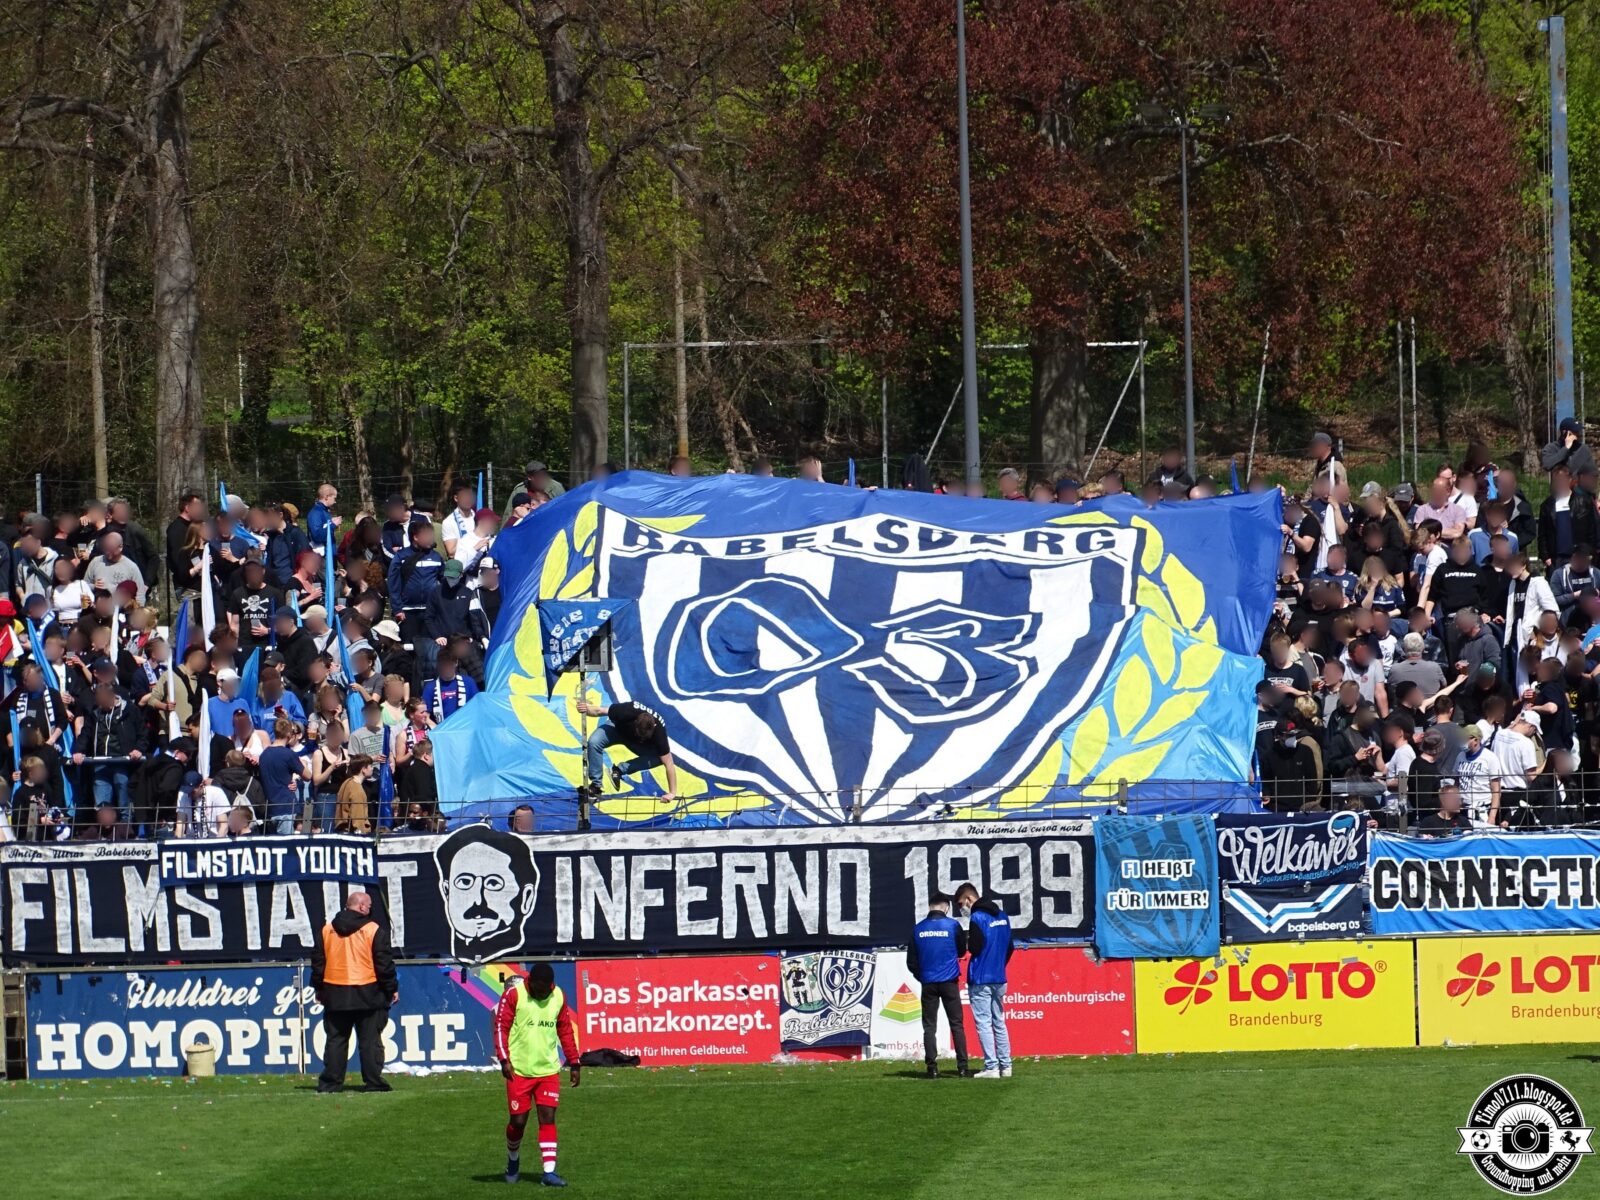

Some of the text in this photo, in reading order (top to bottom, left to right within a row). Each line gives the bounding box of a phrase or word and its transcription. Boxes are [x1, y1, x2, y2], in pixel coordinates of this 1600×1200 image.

[664, 576, 1034, 725] 03
[967, 825, 984, 835] Noi
[987, 825, 1016, 834] siamo
[1017, 824, 1028, 833] la
[1060, 823, 1084, 832] nord
[8, 849, 43, 860] Antifa
[94, 846, 152, 860] Babelsberg
[162, 846, 374, 879] FILMSTADT YOUTH
[1122, 860, 1140, 878] FI
[555, 849, 870, 943] INFERNO
[904, 840, 1084, 931] 1999
[1371, 856, 1600, 911] CONNECTI
[1107, 888, 1209, 909] FÜR IMMER!
[919, 930, 949, 938] ORDNER
[1287, 920, 1360, 932] babelsberg 03
[824, 963, 865, 995] 03
[1229, 961, 1376, 1002] LOTTO
[1511, 955, 1600, 993] LOT
[585, 980, 779, 1008] Das Sparkassen
[1002, 991, 1126, 1005] telbrandenburgische
[586, 1010, 773, 1036] Finanzkonzept.
[783, 1009, 871, 1036] Babelsberg
[1229, 1012, 1323, 1027] Brandenburg
[644, 1047, 657, 1056] für
[660, 1047, 687, 1056] Ihren
[690, 1044, 749, 1056] Geldbeutel.
